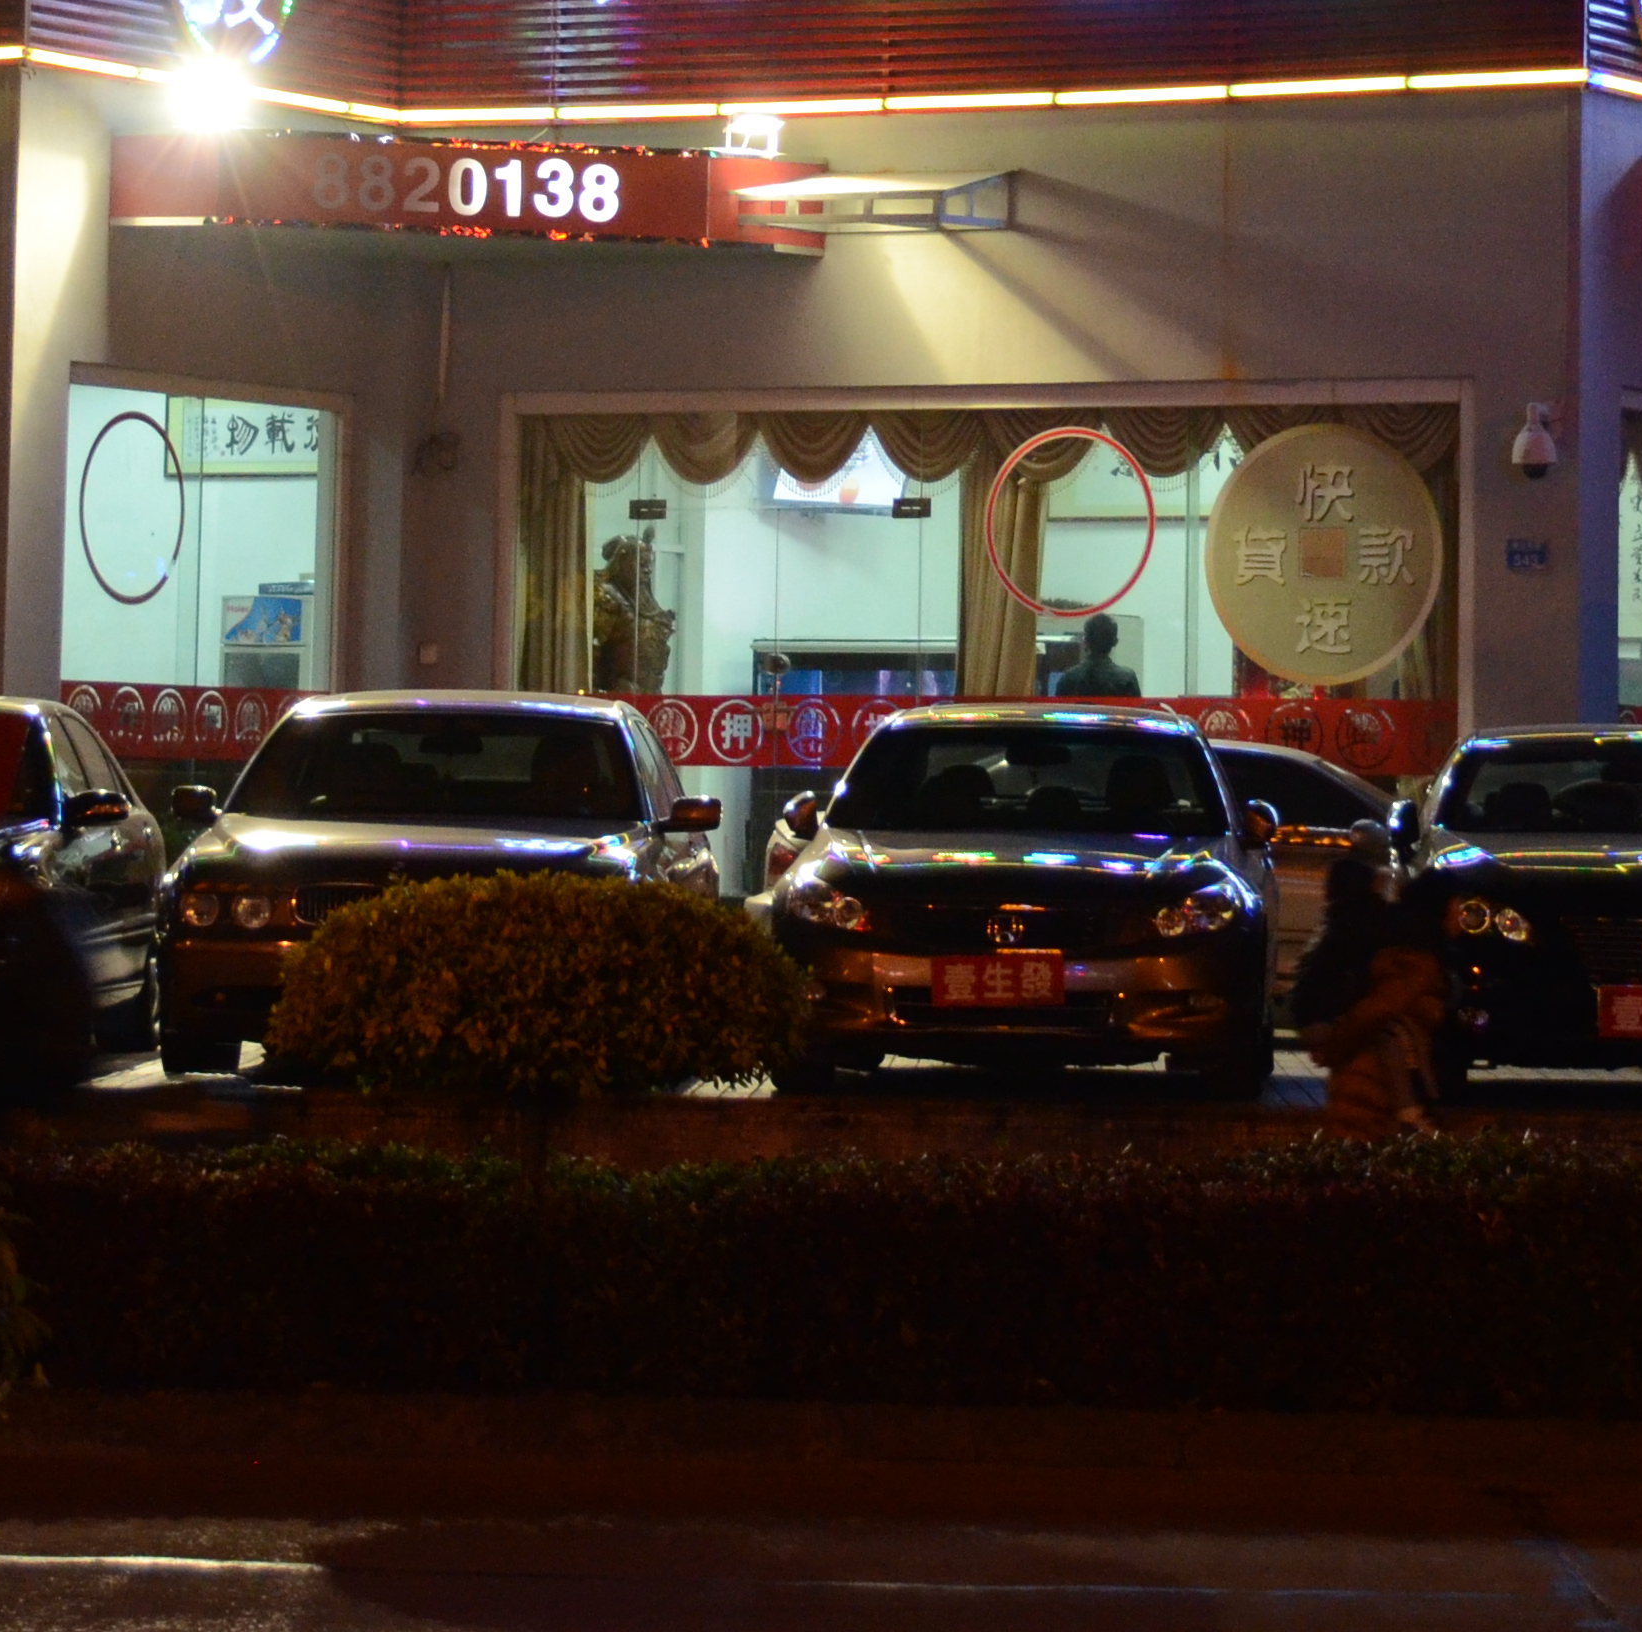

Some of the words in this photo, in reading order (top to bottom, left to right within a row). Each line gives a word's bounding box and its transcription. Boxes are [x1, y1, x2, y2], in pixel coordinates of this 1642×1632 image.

[312, 151, 621, 224] 8820138
[720, 712, 753, 750] 押
[943, 960, 1054, 1001] 壹生發
